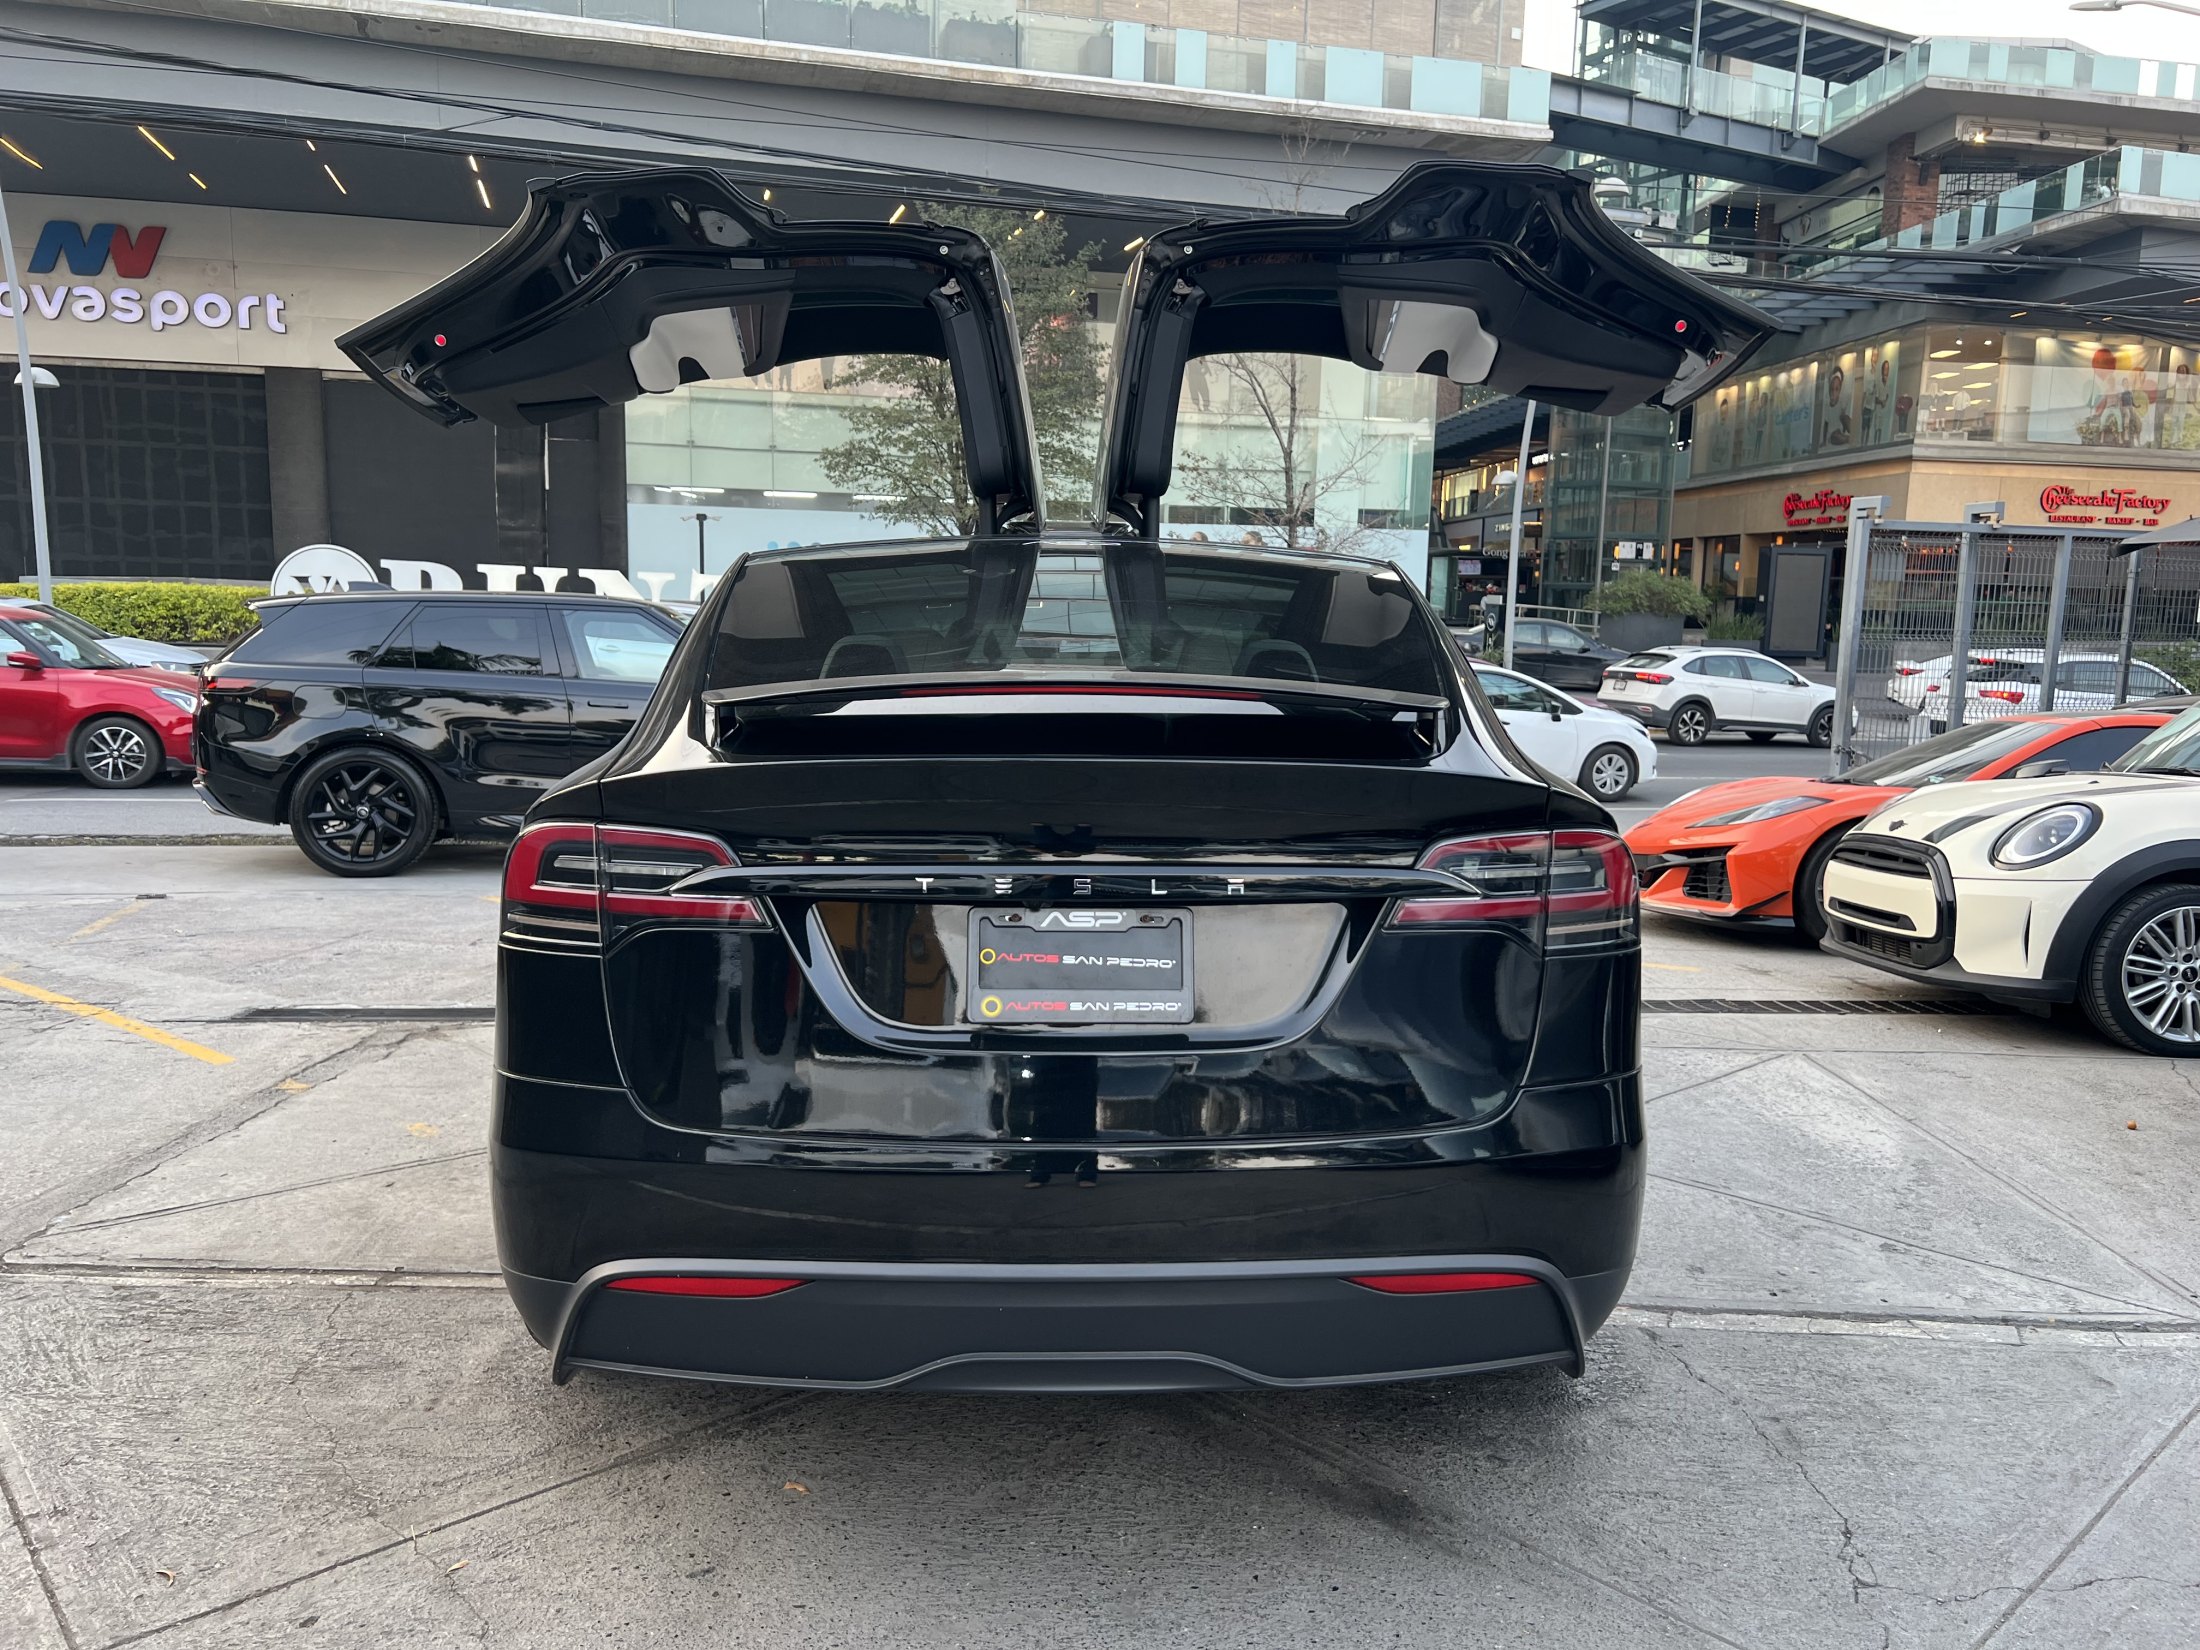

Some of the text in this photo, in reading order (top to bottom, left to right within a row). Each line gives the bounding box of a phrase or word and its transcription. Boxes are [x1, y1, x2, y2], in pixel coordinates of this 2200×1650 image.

[2040, 485, 2172, 515] Cheesecake Factory
[1482, 547, 1509, 560] Gong
[914, 877, 1245, 895] TESLA
[1040, 911, 1123, 928] ASP
[997, 952, 1060, 964] AUTOS
[1062, 955, 1103, 966] SAN
[1005, 1001, 1068, 1011] AUTOS
[1069, 1001, 1110, 1011] SAN
